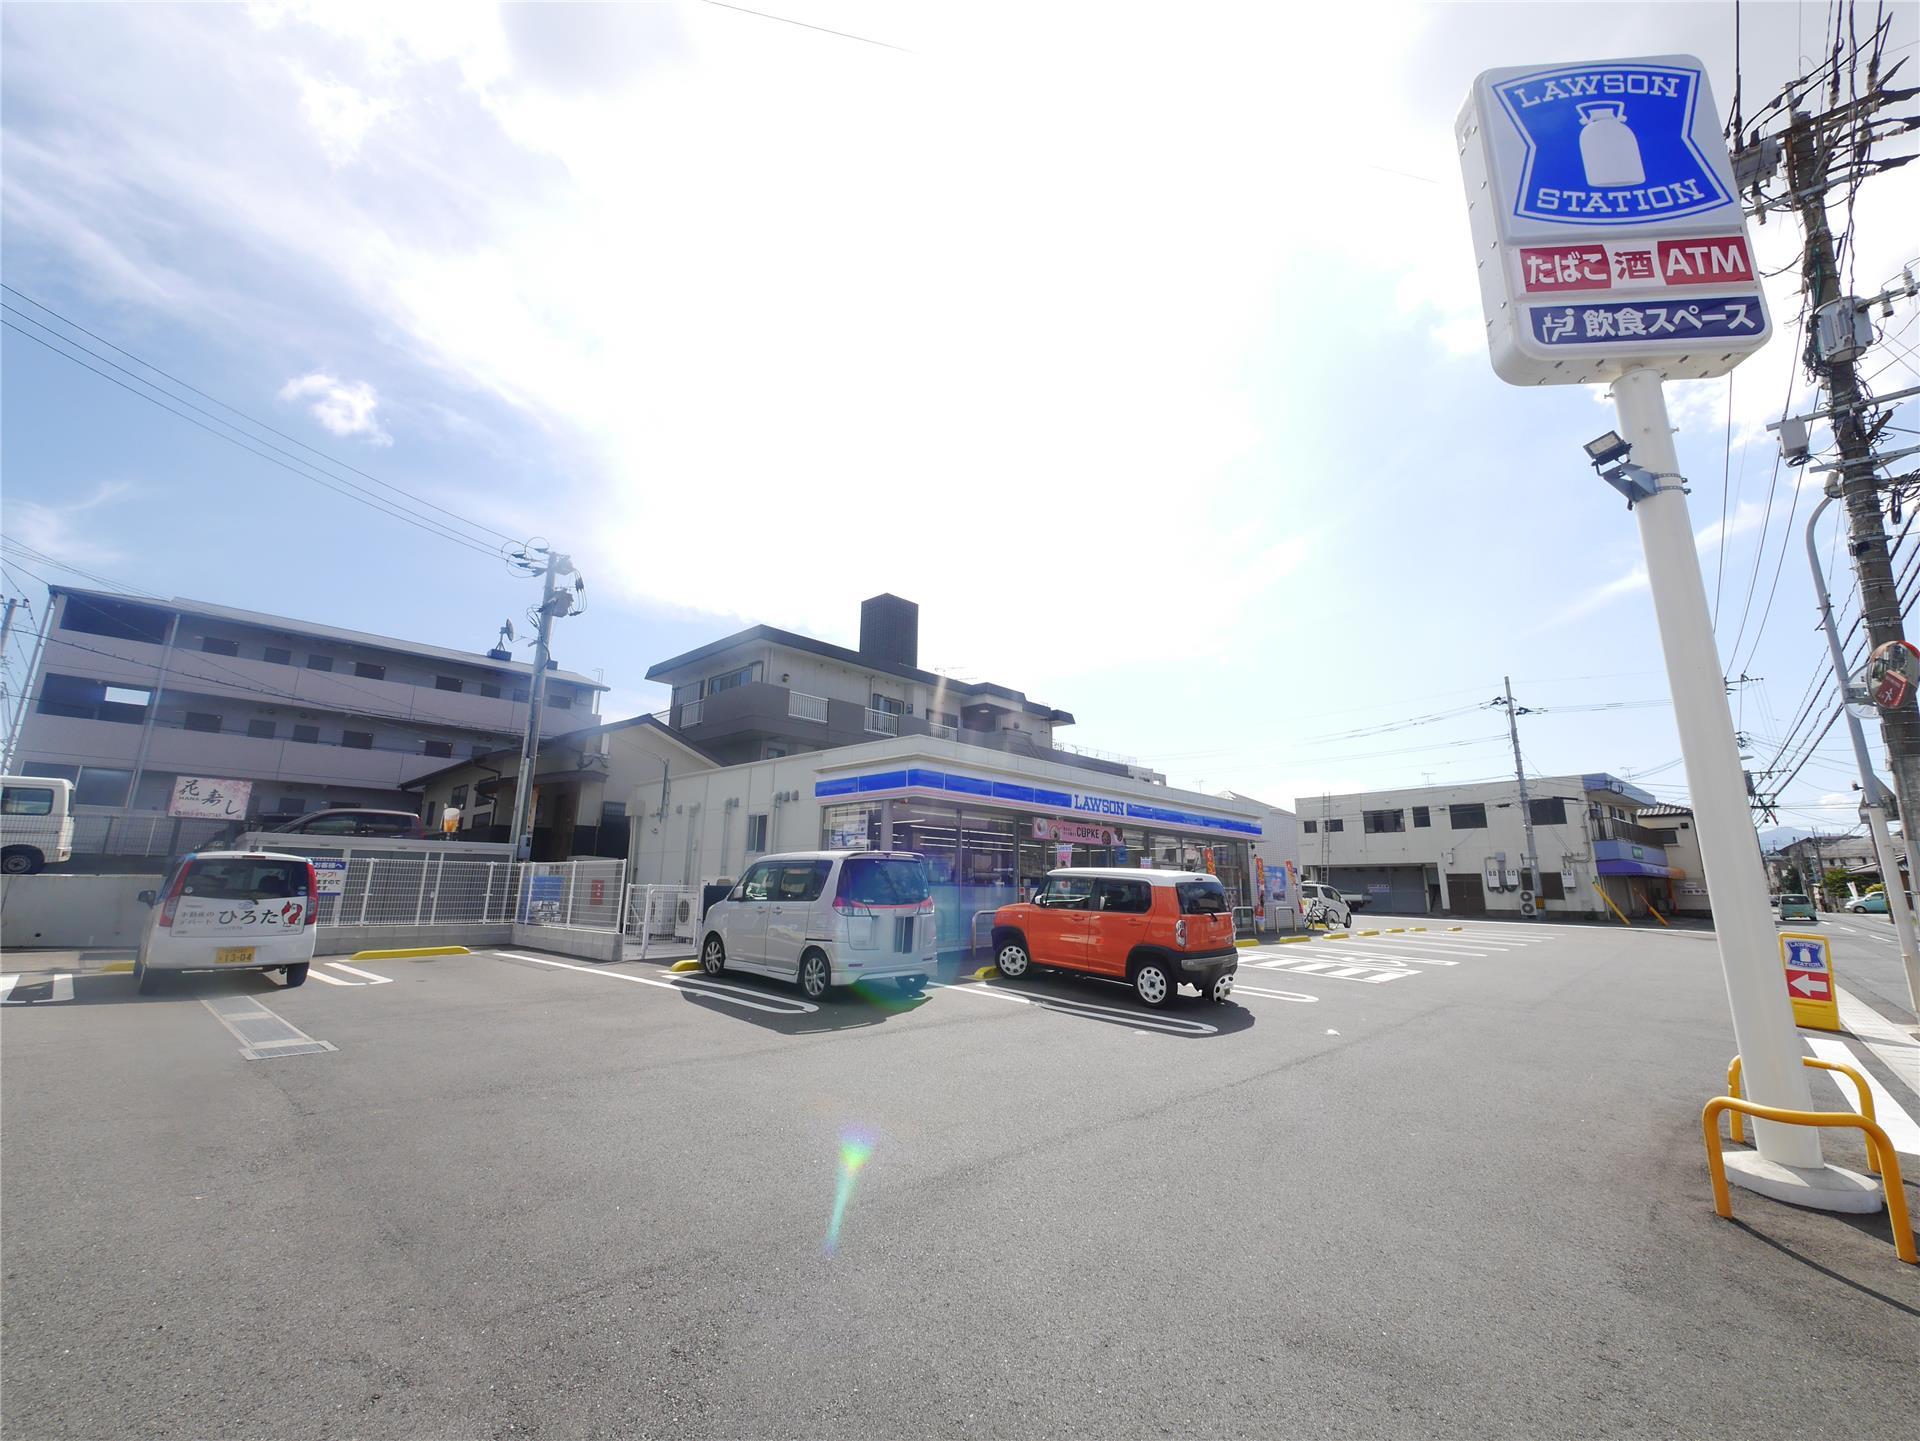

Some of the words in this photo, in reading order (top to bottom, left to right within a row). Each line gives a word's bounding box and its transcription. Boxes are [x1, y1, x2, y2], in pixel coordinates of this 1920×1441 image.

[1514, 74, 1680, 108] LAWSON
[1536, 178, 1705, 213] STATION
[1527, 251, 1607, 285] たばこ
[1614, 250, 1655, 280] 酒
[1666, 245, 1746, 276] ATM
[1583, 304, 1755, 338] 飲食スペース
[1074, 794, 1124, 816] LAWSON
[1076, 826, 1100, 839] CUPKE
[219, 909, 279, 925] ひろた
[1788, 941, 1819, 950] LAWSON
[1791, 960, 1822, 968] STATION
